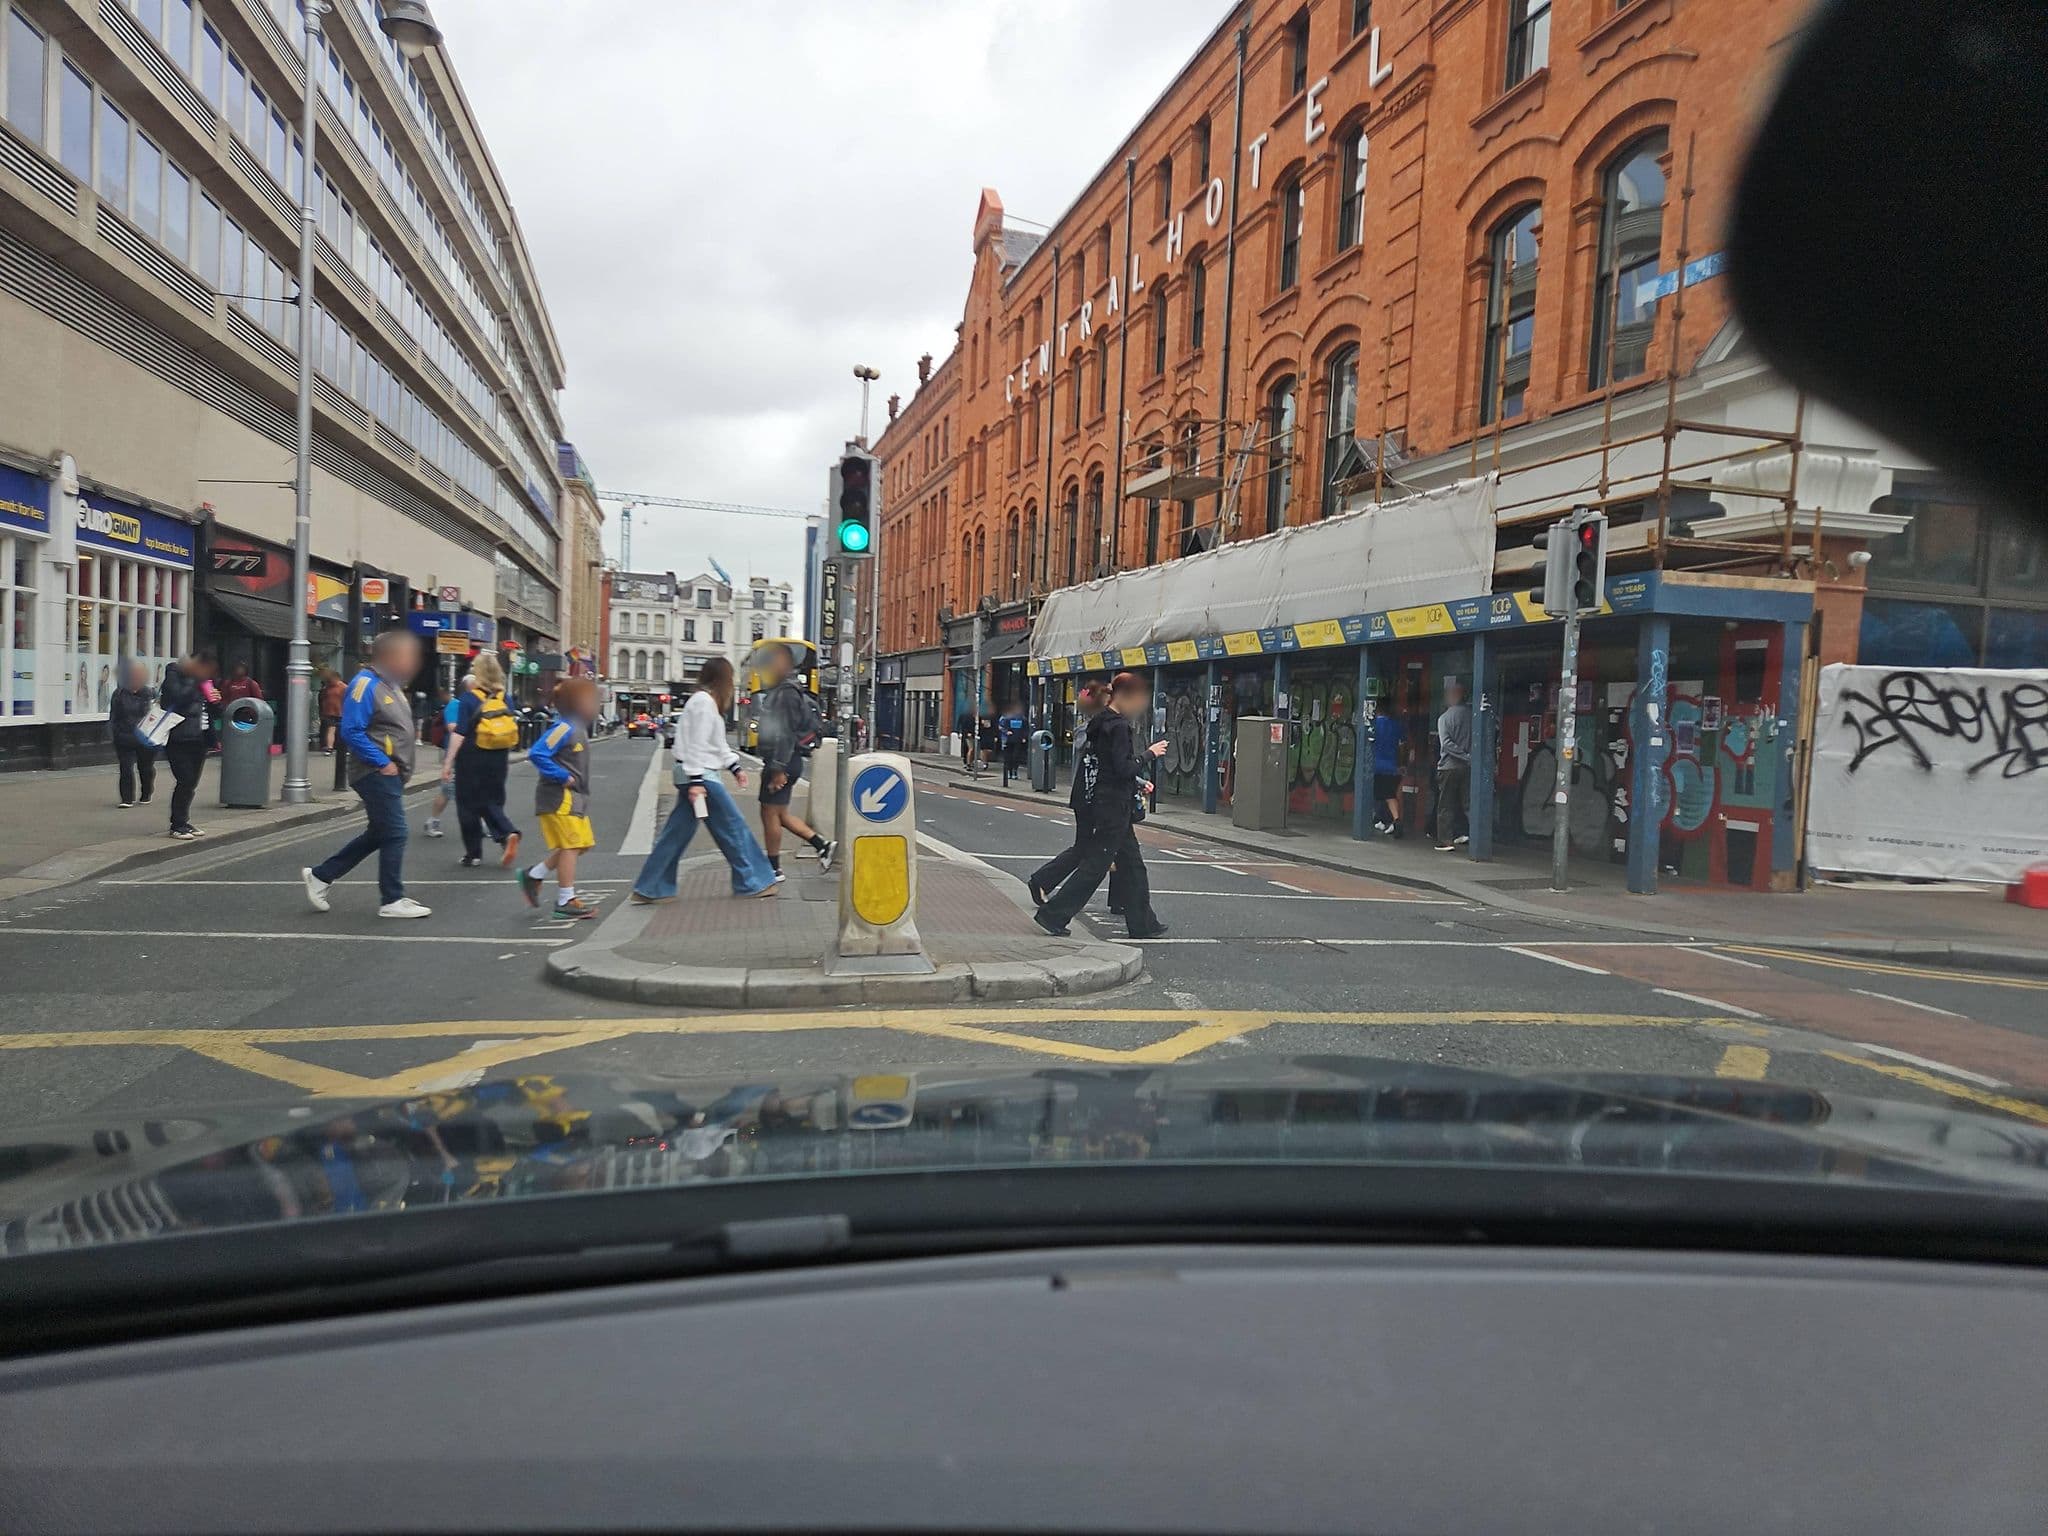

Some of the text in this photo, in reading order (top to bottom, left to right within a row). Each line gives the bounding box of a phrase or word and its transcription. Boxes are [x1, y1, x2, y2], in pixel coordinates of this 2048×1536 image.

[1005, 26, 1394, 404] CENTRAL HOTEL
[214, 554, 261, 571] 777
[1625, 583, 1647, 593] YEARS
[1491, 598, 1512, 615] 100
